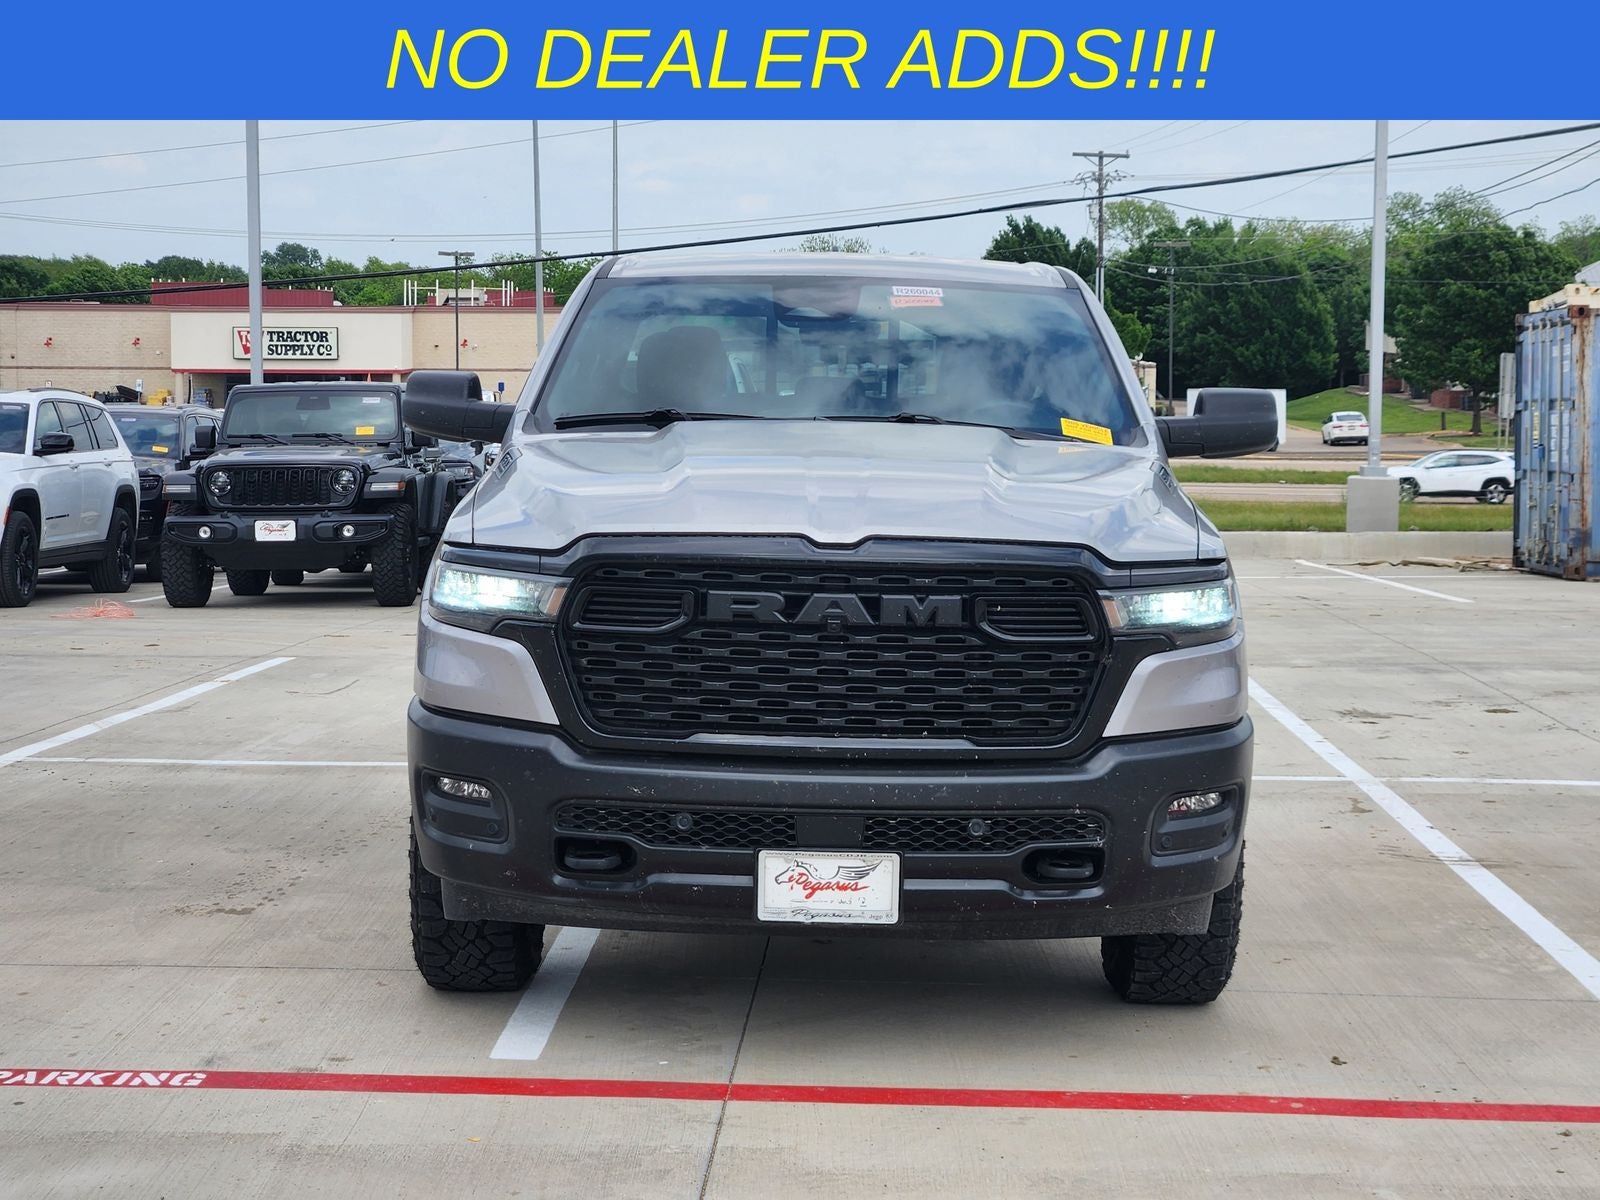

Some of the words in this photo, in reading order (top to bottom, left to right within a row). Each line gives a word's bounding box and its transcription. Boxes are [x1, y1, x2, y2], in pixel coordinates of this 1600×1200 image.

[267, 331, 329, 343] TRACTOR
[267, 344, 315, 356] SUPPLY
[706, 590, 962, 627] RAM
[788, 872, 870, 899] Pegasus
